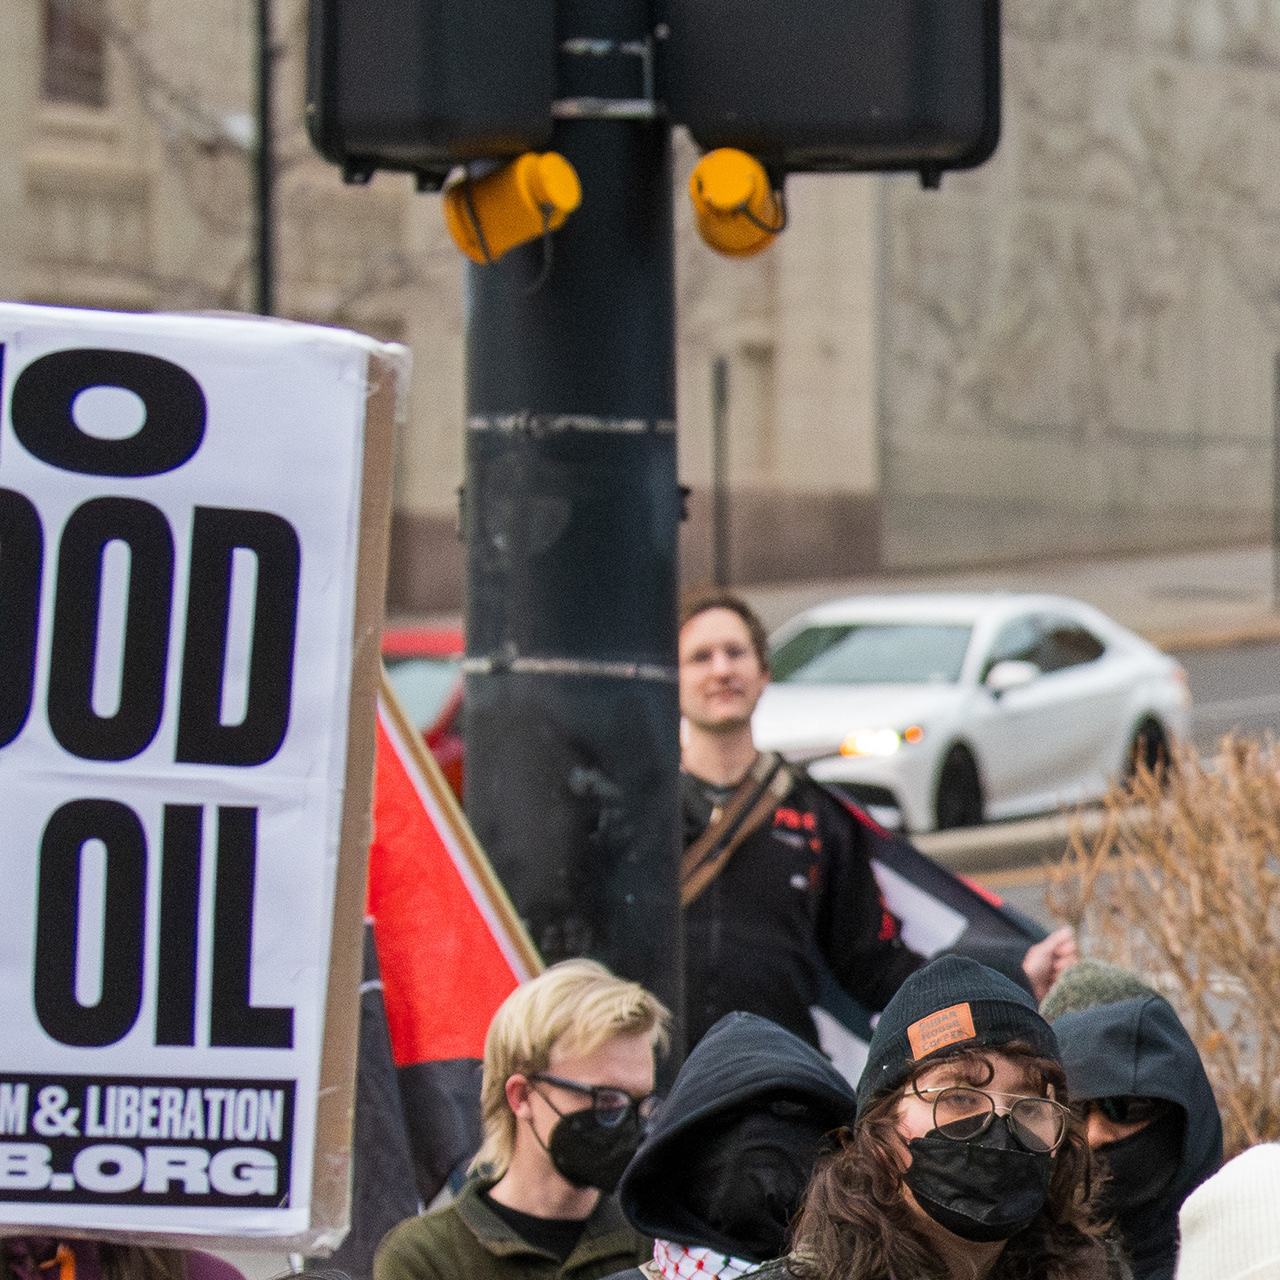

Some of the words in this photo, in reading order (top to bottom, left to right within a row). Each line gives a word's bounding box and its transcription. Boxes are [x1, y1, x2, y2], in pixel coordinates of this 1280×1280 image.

[0, 342, 208, 478] O
[32, 797, 294, 1050] OIL
[32, 1085, 80, 1138] &
[85, 1085, 284, 1142] LIBERATION
[0, 1142, 278, 1196] B.ORG
